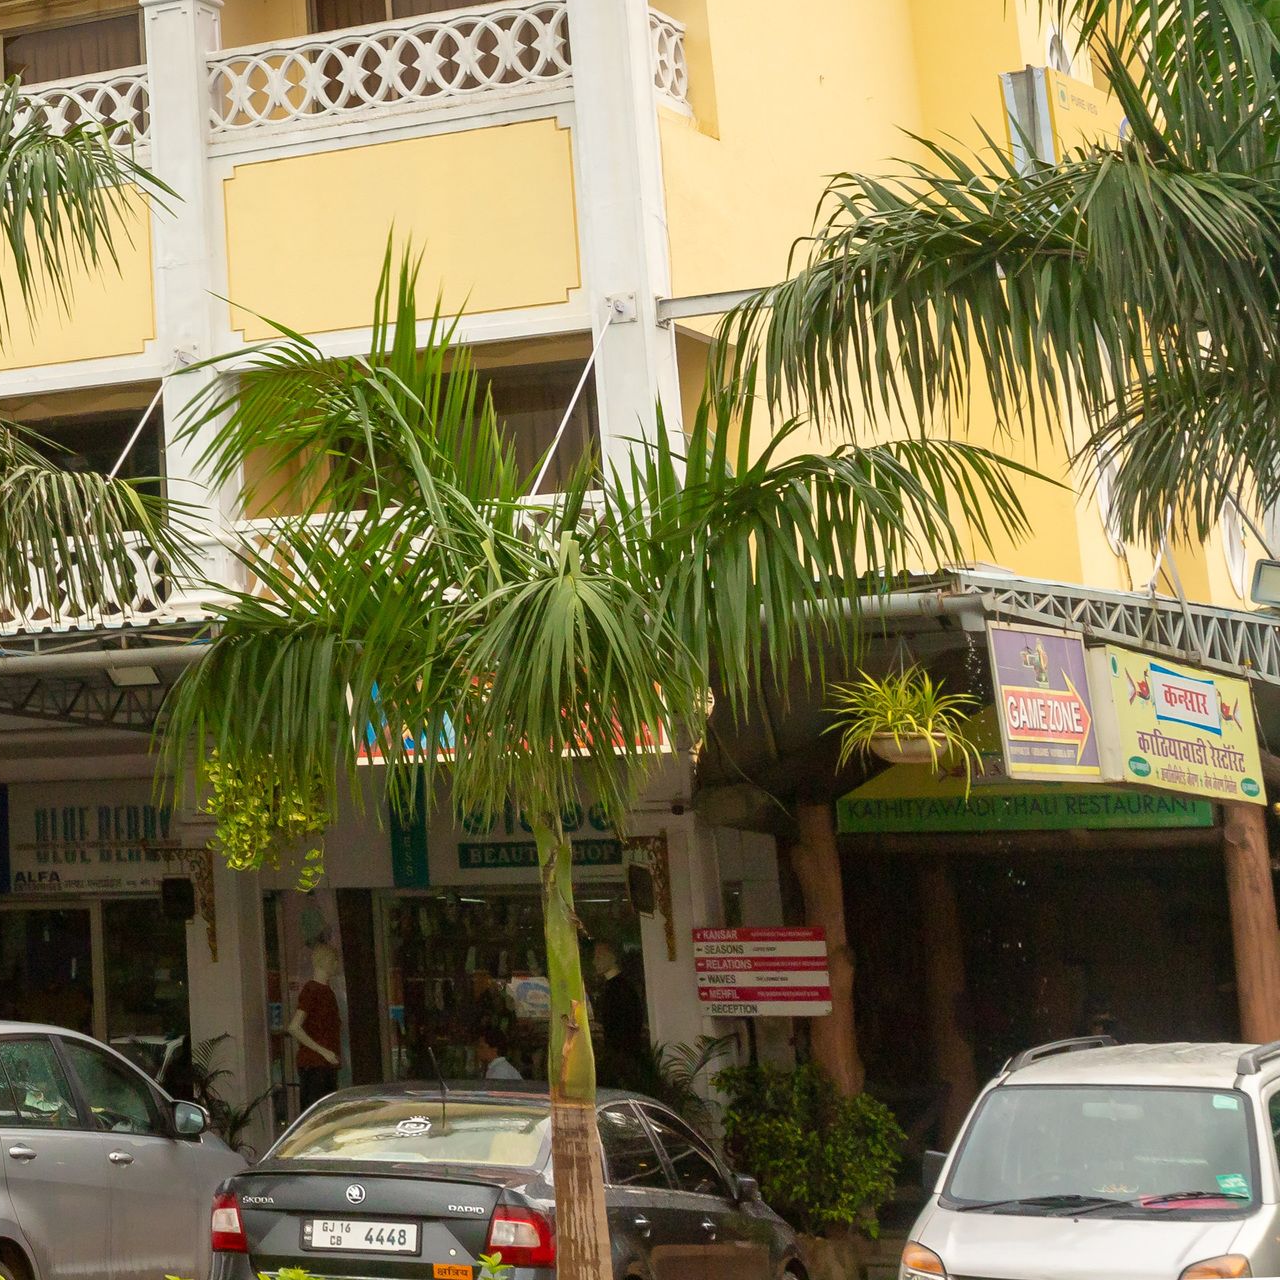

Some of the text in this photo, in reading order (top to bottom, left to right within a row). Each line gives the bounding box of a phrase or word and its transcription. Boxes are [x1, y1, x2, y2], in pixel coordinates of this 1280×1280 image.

[1162, 683, 1209, 715] कन्सार
[1007, 696, 1083, 733] GAME ZONE
[1066, 794, 1198, 816] RESTAURANT
[470, 844, 616, 864] BEAUT HOP
[703, 930, 737, 939] KANSAR
[704, 945, 744, 954] SEASONS
[706, 960, 752, 969] RELATIONS
[708, 974, 736, 984] WAVES
[712, 1004, 758, 1014] RECEPTION
[448, 1204, 485, 1214] RAPID
[322, 1221, 351, 1233] GJ 16
[330, 1235, 342, 1246] CB
[364, 1228, 407, 1246] 4448
[437, 1266, 468, 1277] क्षत्रिय
